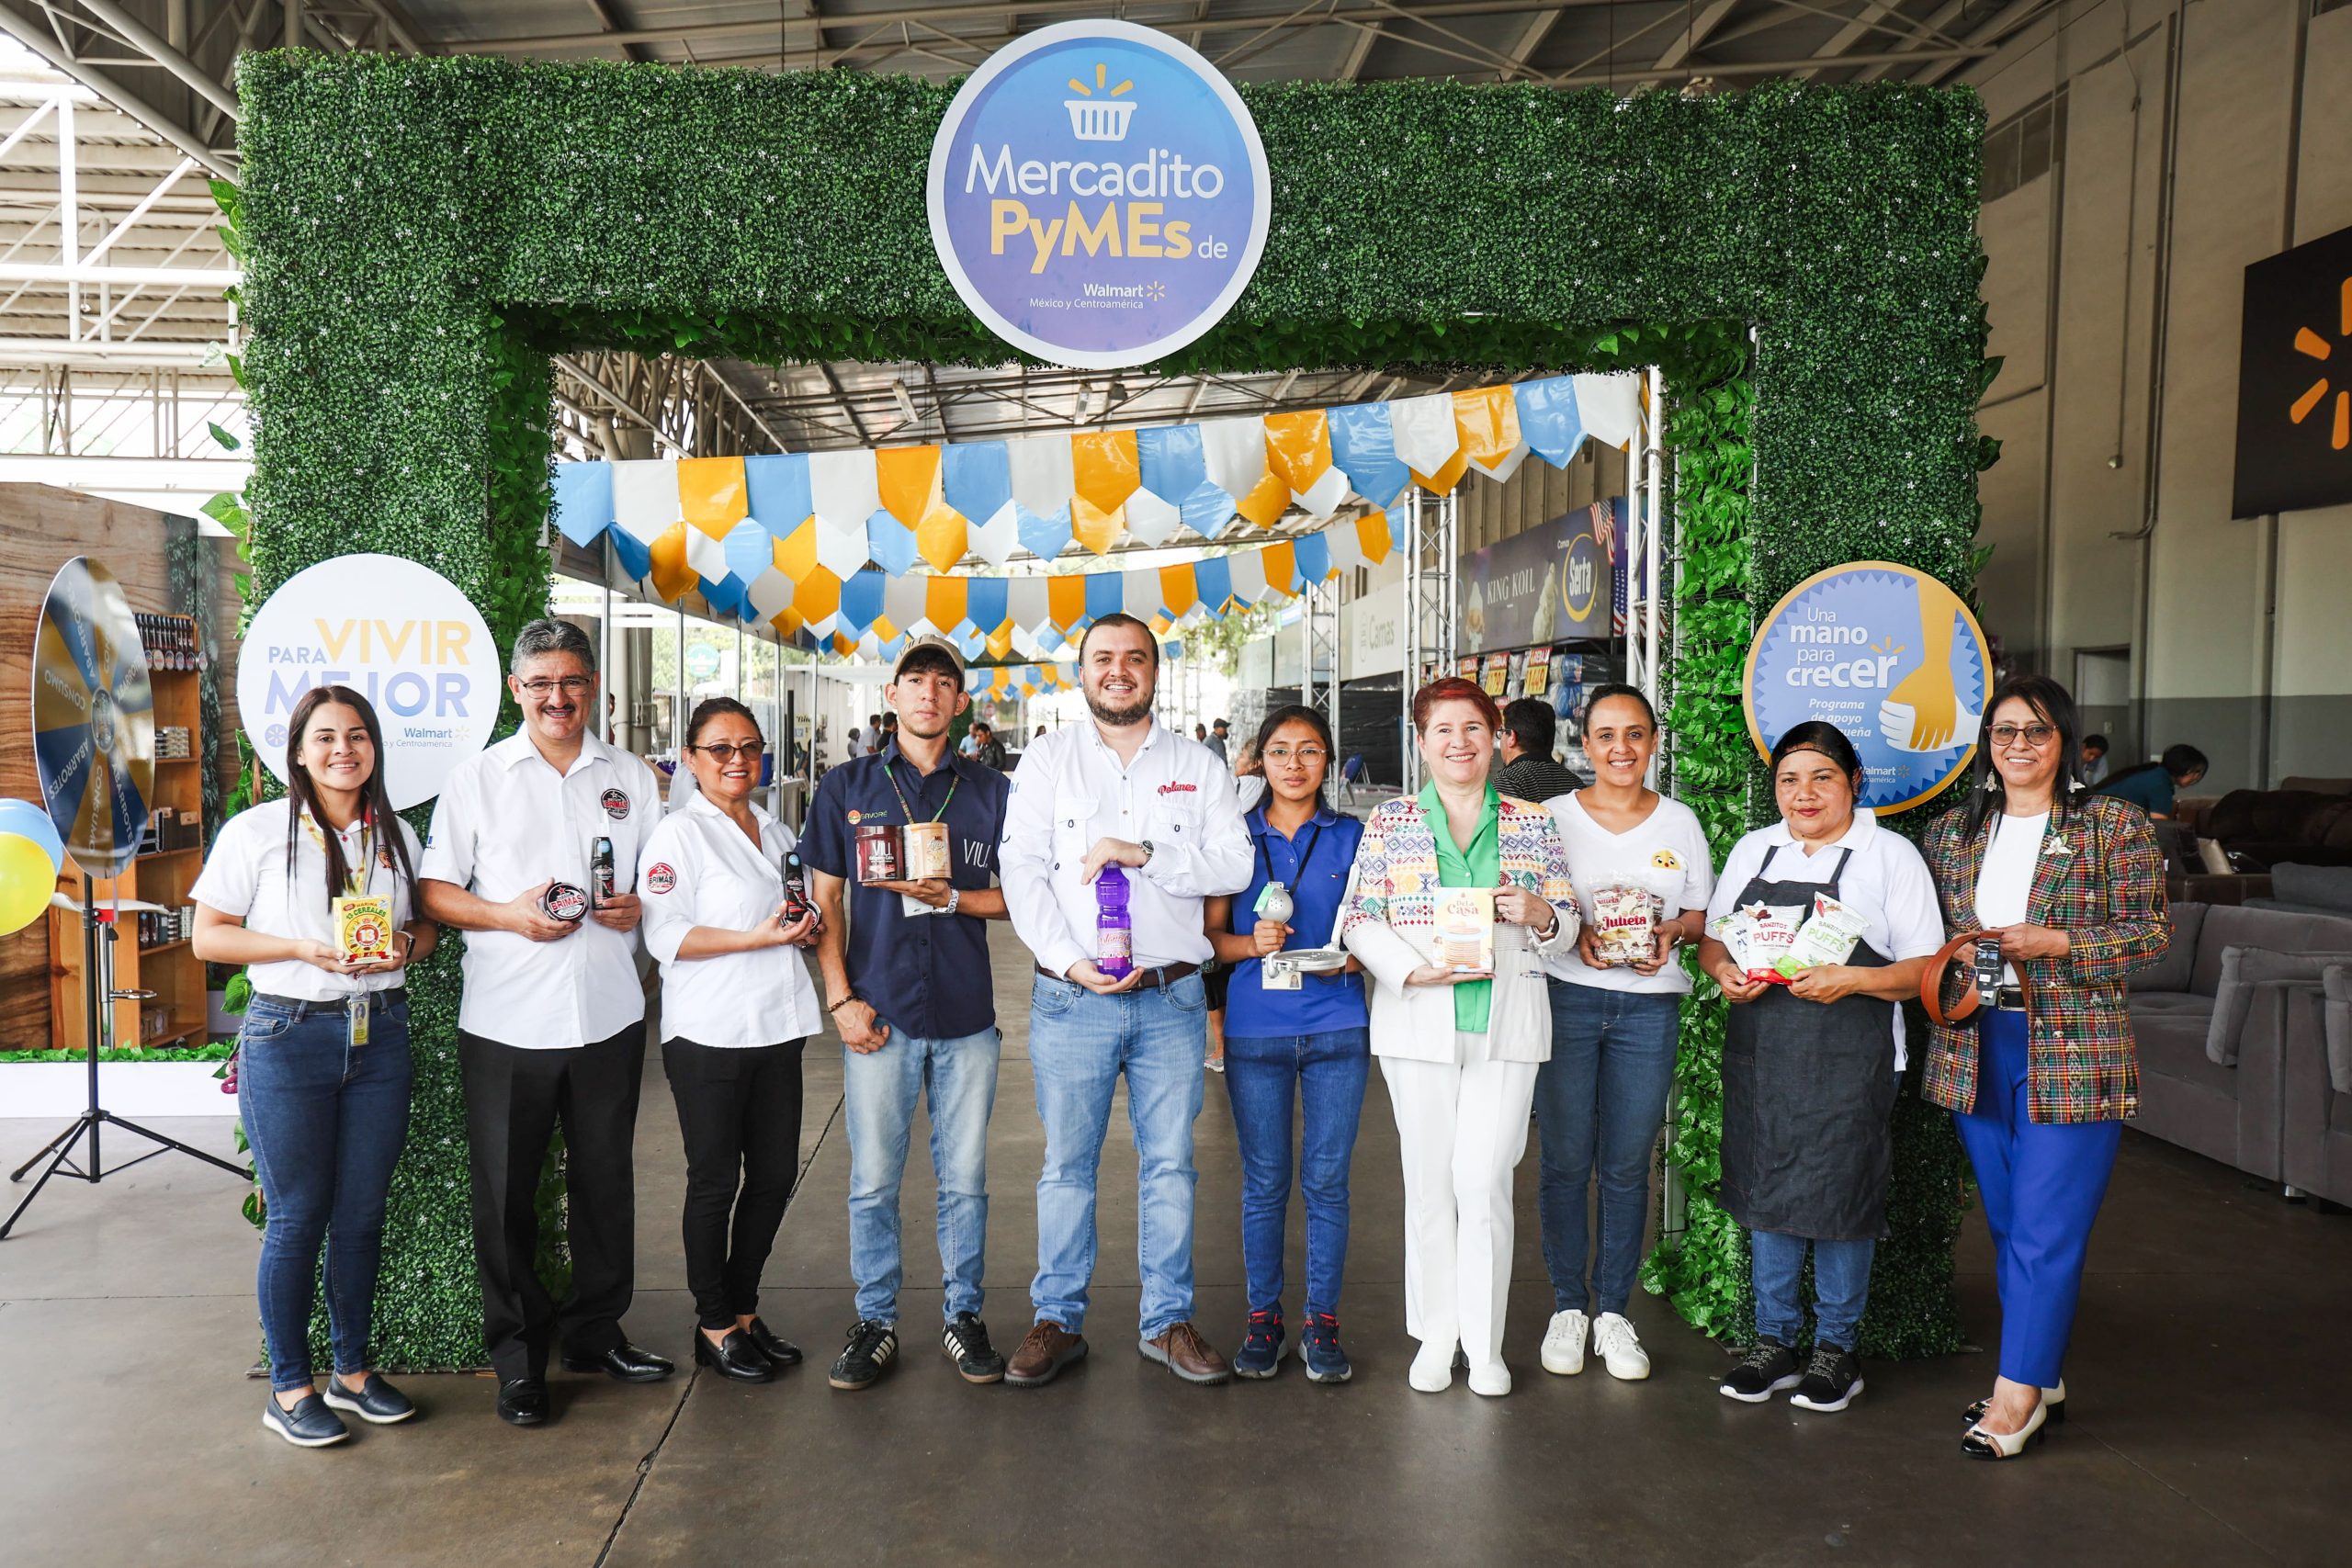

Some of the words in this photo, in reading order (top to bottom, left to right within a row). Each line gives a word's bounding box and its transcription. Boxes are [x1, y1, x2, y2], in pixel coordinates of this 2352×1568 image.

[965, 143, 1225, 199] Mercadito
[990, 198, 1193, 274] PyMEs
[1197, 235, 1228, 259] de
[1083, 283, 1144, 298] Walmart
[1029, 297, 1064, 309] México
[1066, 300, 1071, 310] y
[1074, 298, 1144, 310] Centroamérica
[1569, 557, 1591, 596] Serta
[1487, 576, 1509, 604] KING
[1511, 568, 1535, 597] KOIL
[1807, 607, 1836, 622] Una
[1369, 615, 1395, 650] Camas
[1790, 625, 1868, 645] mano
[268, 646, 327, 664] PARA
[314, 619, 471, 665] VIVIR
[1797, 647, 1835, 665] para
[1786, 655, 1897, 688] crecer
[44, 670, 85, 710] CONSUMO
[1808, 698, 1865, 711] Programa
[1811, 713, 1826, 721] de
[1828, 714, 1862, 725] apoyo
[404, 728, 453, 739] Walmart
[396, 739, 452, 748] Centroamérica
[48, 738, 89, 800] ABARROTES
[89, 765, 103, 852] CONSUMO
[112, 763, 135, 852] ABARROTES
[604, 800, 628, 809] BRIMAS
[860, 810, 888, 818] SAVORÉ
[872, 841, 891, 855] VIU
[649, 875, 673, 886] BRIMAS
[550, 895, 583, 910] BRIMAS
[1447, 904, 1479, 916] Casa
[354, 907, 386, 917] CEREALES
[1602, 915, 1646, 931] Julieta
[1753, 931, 1794, 943] PUFFS
[1808, 927, 1846, 952] PUFFS
